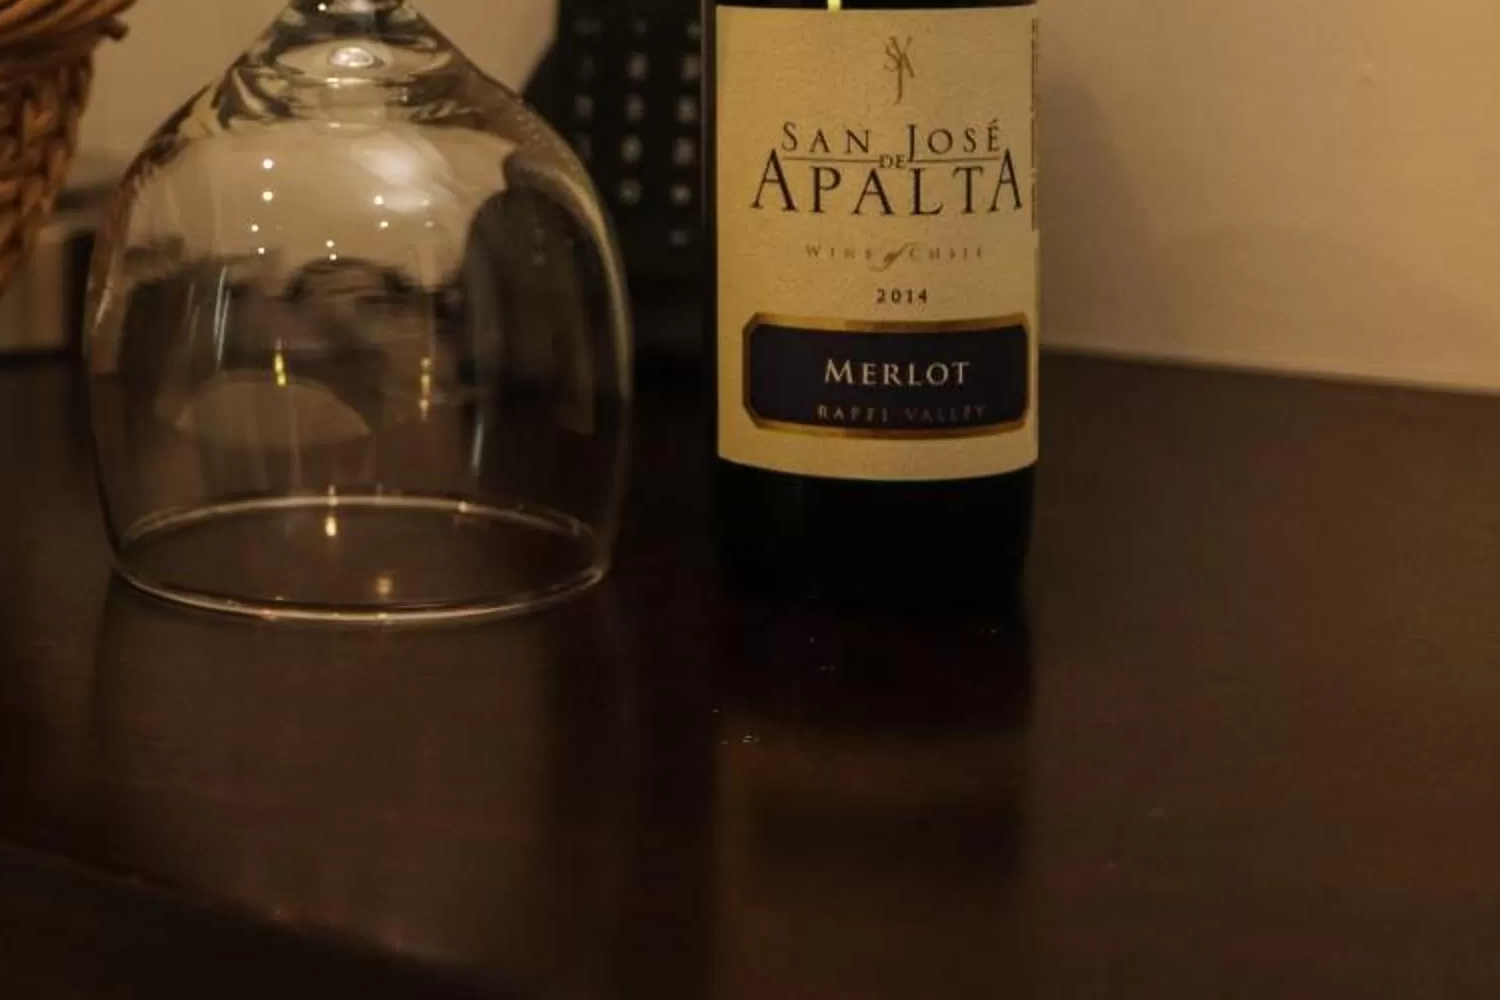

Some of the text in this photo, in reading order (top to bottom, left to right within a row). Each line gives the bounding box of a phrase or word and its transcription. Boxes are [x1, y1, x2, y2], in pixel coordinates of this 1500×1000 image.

[781, 117, 1000, 163] SAN JOSÉ
[879, 153, 905, 169] DE
[750, 148, 1024, 216] APALTA
[875, 287, 928, 305] 2014
[823, 358, 971, 387] MERLOT
[904, 403, 987, 423] VALLEY
